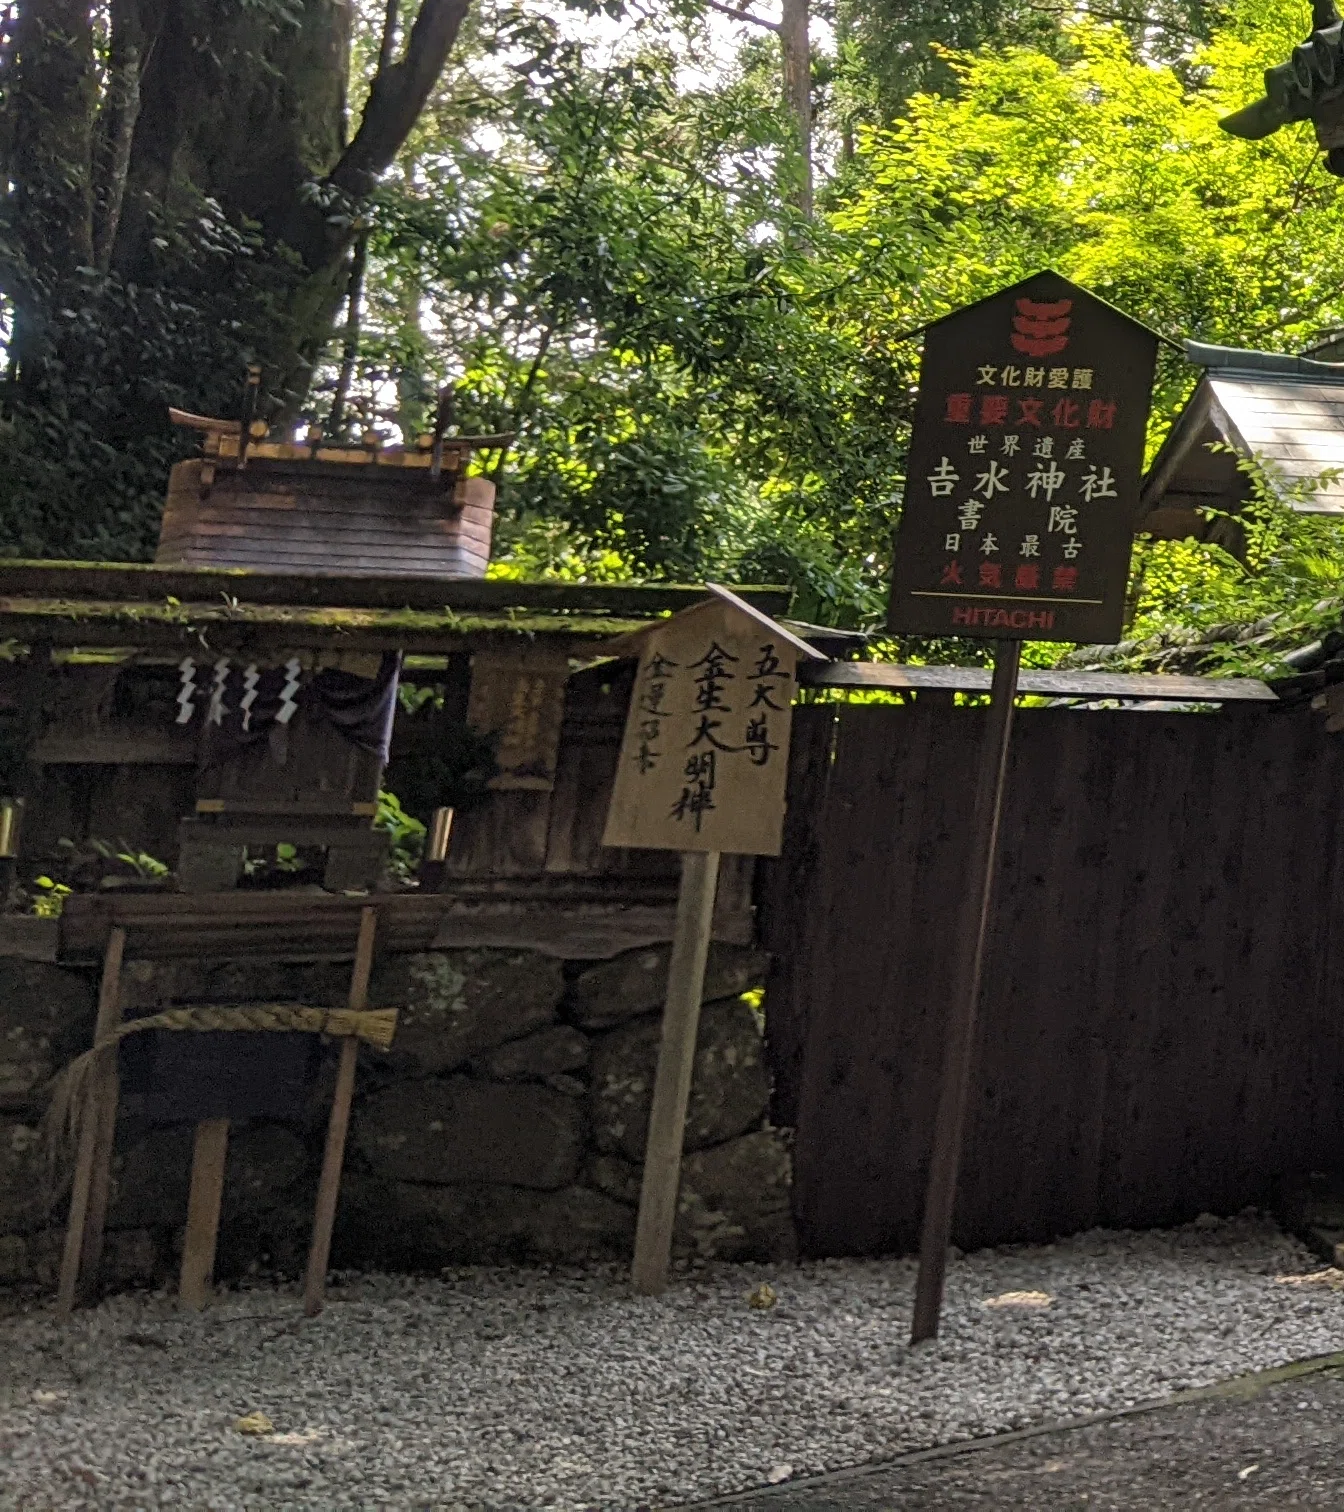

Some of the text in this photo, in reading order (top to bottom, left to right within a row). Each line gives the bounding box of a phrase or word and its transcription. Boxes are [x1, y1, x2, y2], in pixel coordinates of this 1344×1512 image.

[977, 364, 1095, 390] 文化財愛護
[944, 392, 1118, 430] 重要文化財
[967, 434, 1087, 461] 世界遺産
[944, 533, 1083, 560] 日本最古
[951, 606, 1056, 630] HITACHI
